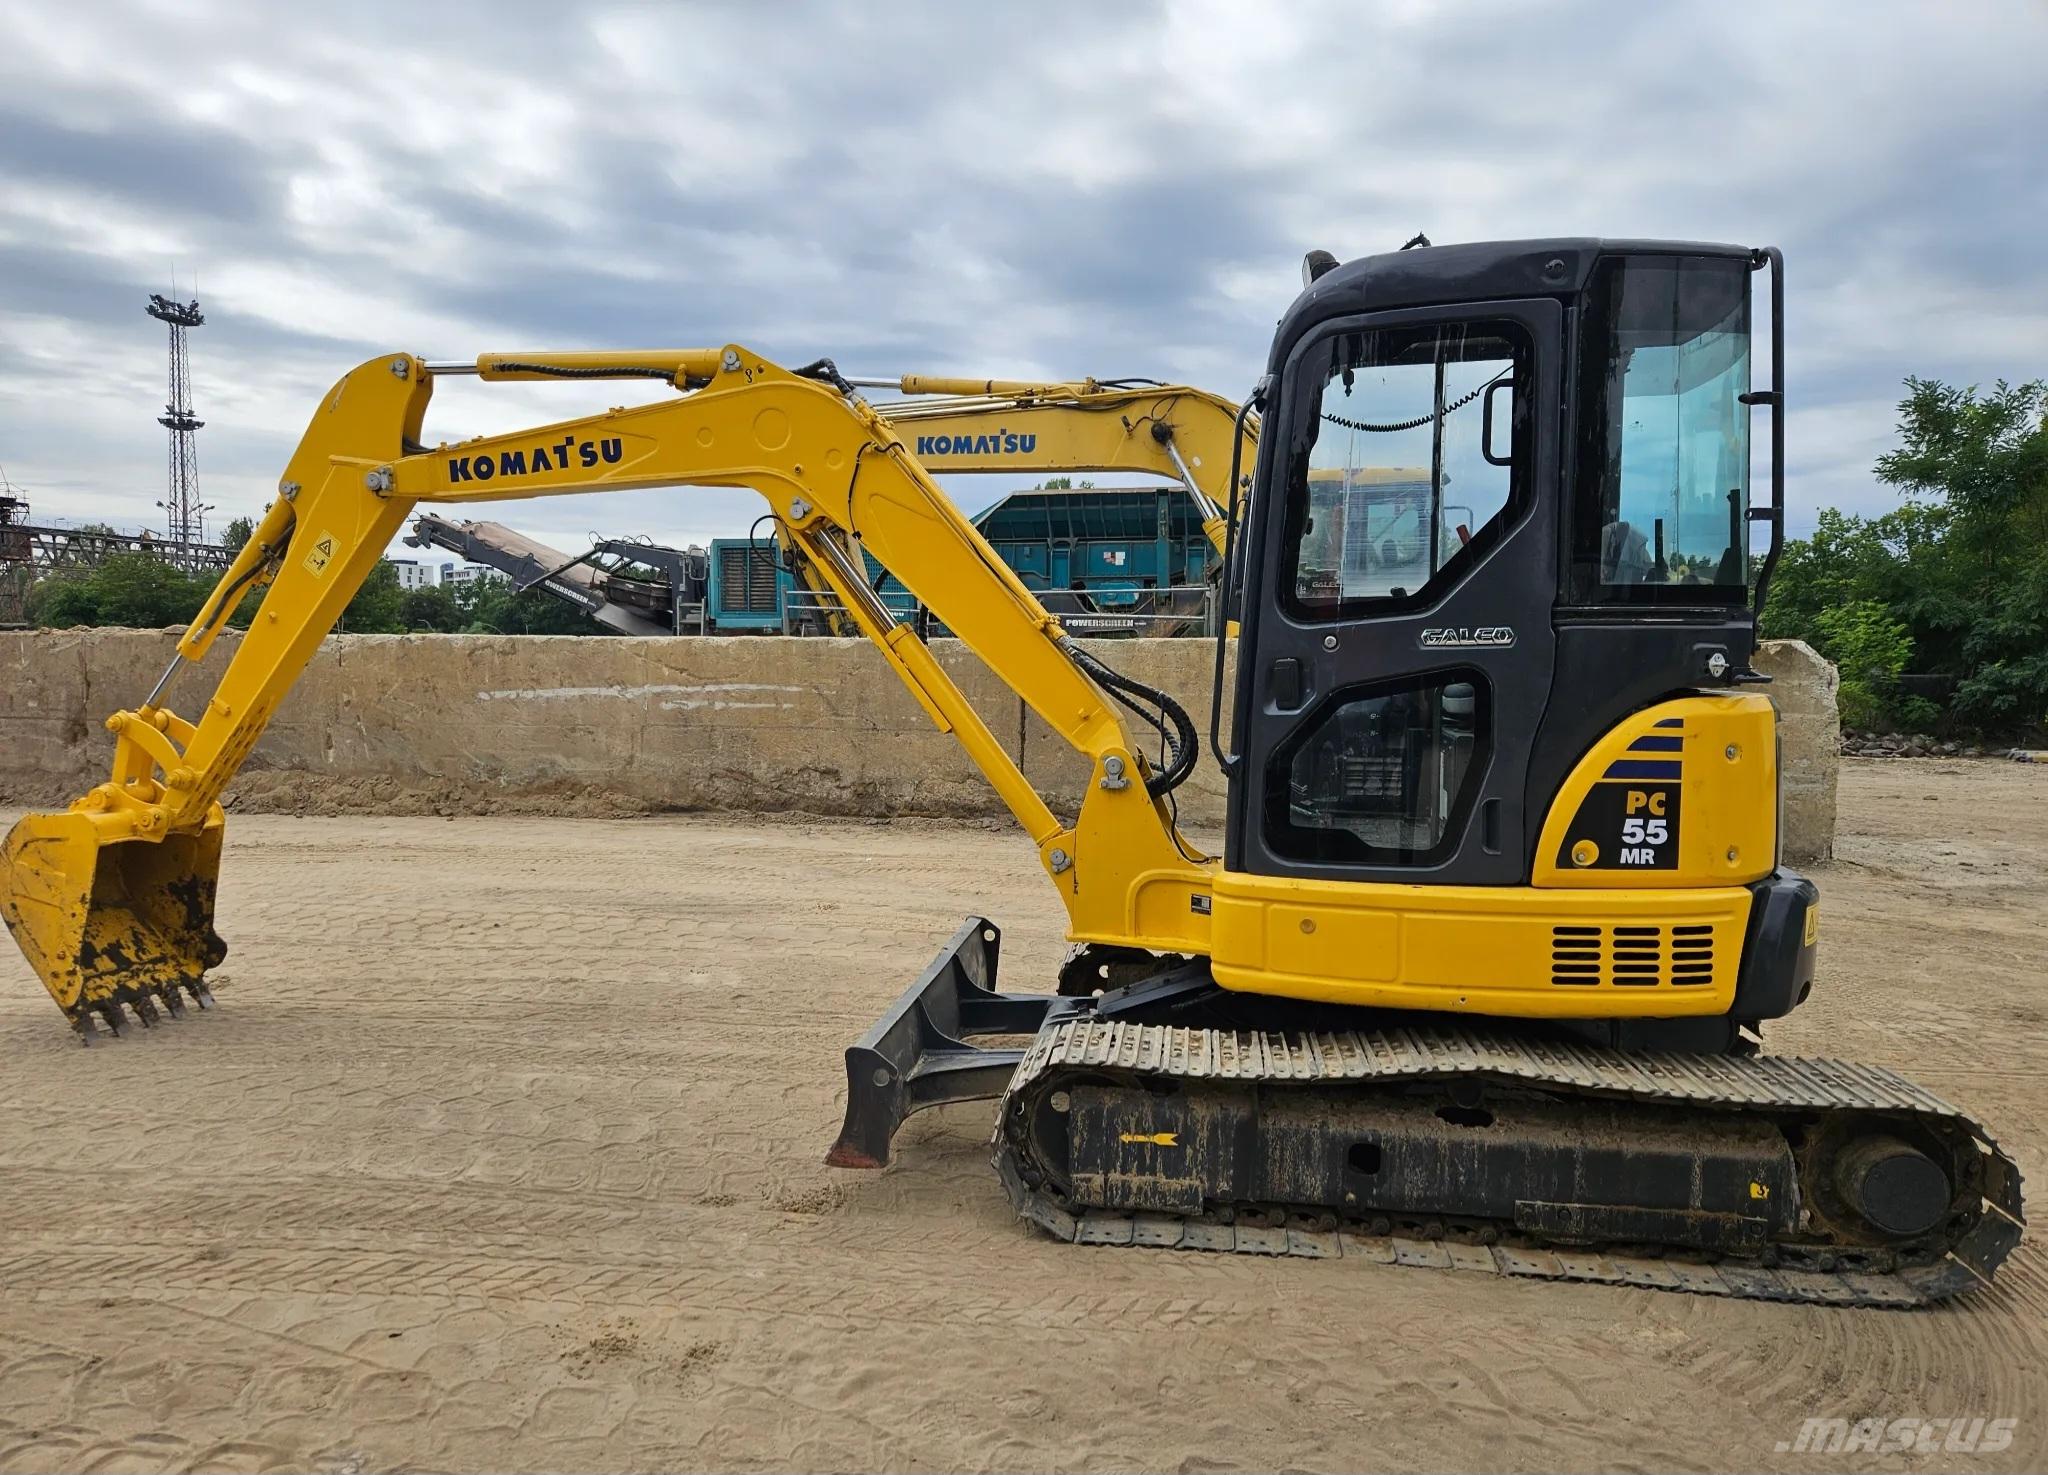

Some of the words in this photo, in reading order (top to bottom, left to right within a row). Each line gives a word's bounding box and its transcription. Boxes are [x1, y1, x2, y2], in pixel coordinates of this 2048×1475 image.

[918, 428, 1036, 455] KOMATSU
[449, 436, 623, 482] KOMATSU
[1065, 619, 1134, 627] POWERSCREEN
[1421, 627, 1514, 645] GALEO
[1627, 791, 1666, 816] PC
[1621, 818, 1668, 845] 55
[1620, 848, 1655, 865] MR
